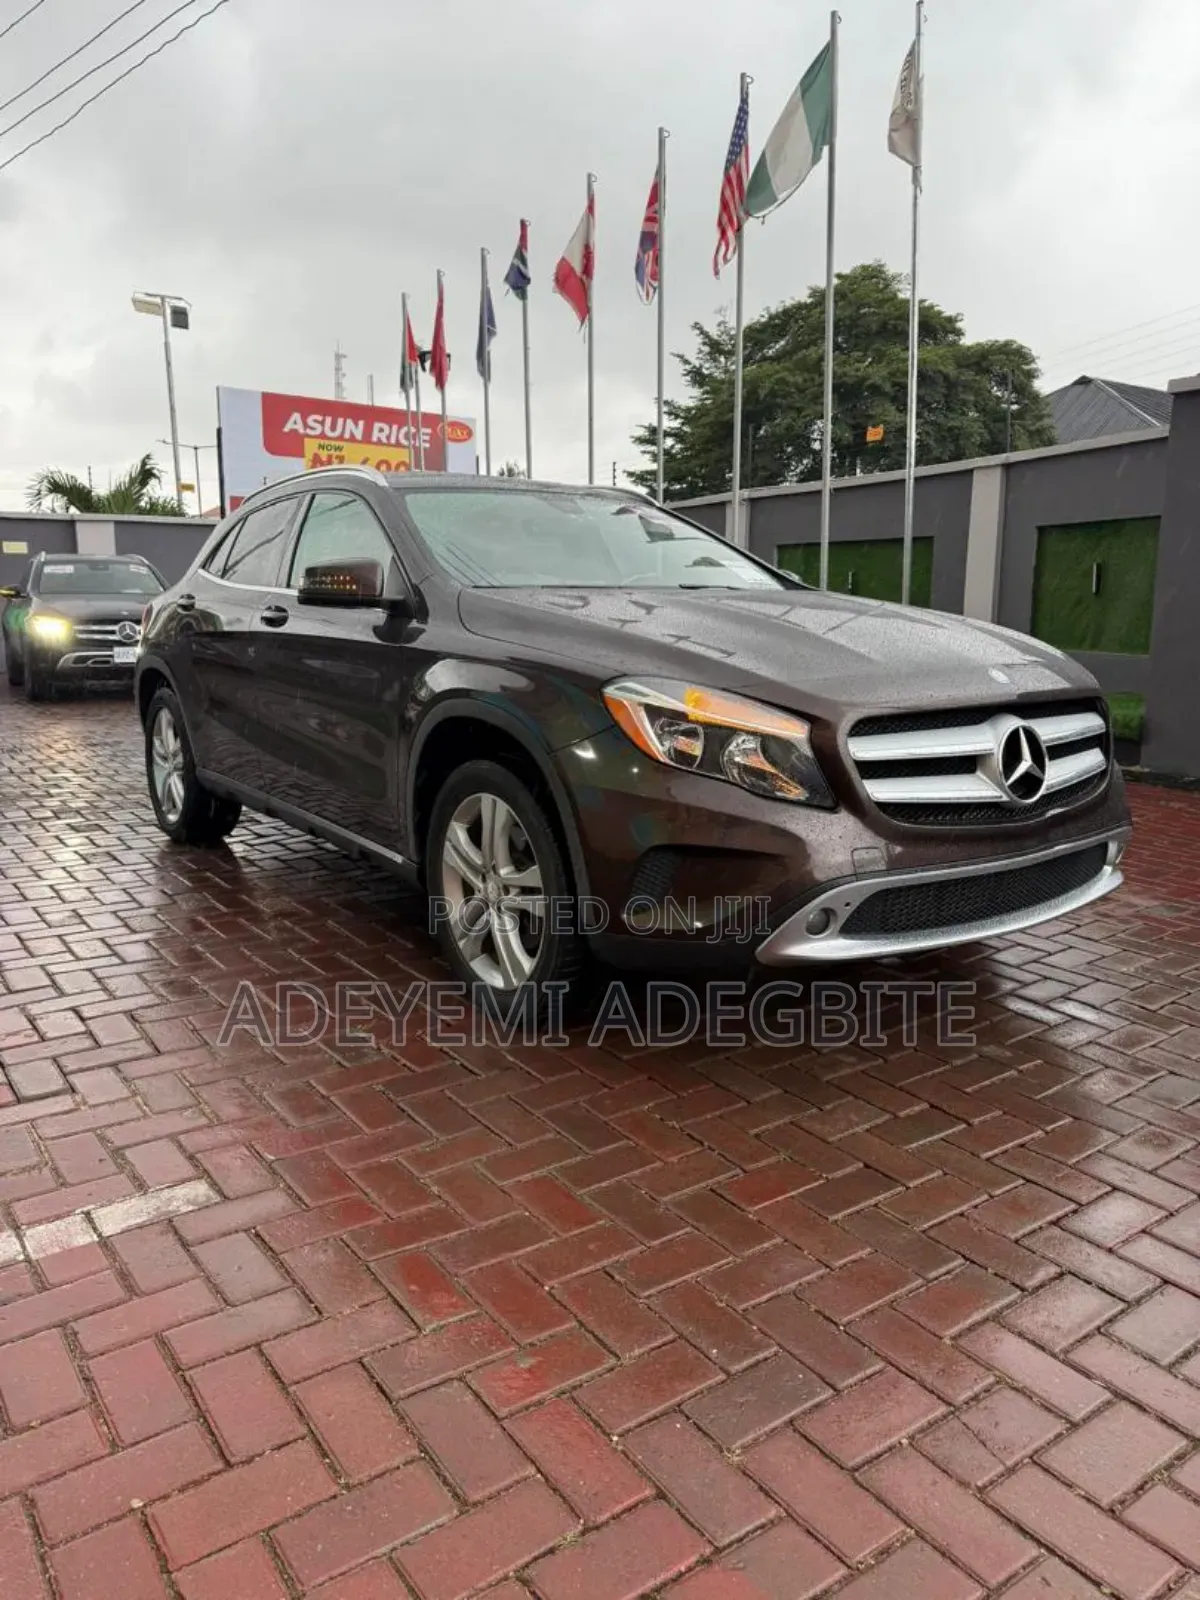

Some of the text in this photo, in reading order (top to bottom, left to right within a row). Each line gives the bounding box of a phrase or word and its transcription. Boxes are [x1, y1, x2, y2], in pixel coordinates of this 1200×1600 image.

[282, 412, 364, 440] ASUN
[372, 421, 432, 447] RICE
[318, 443, 344, 452] NOW
